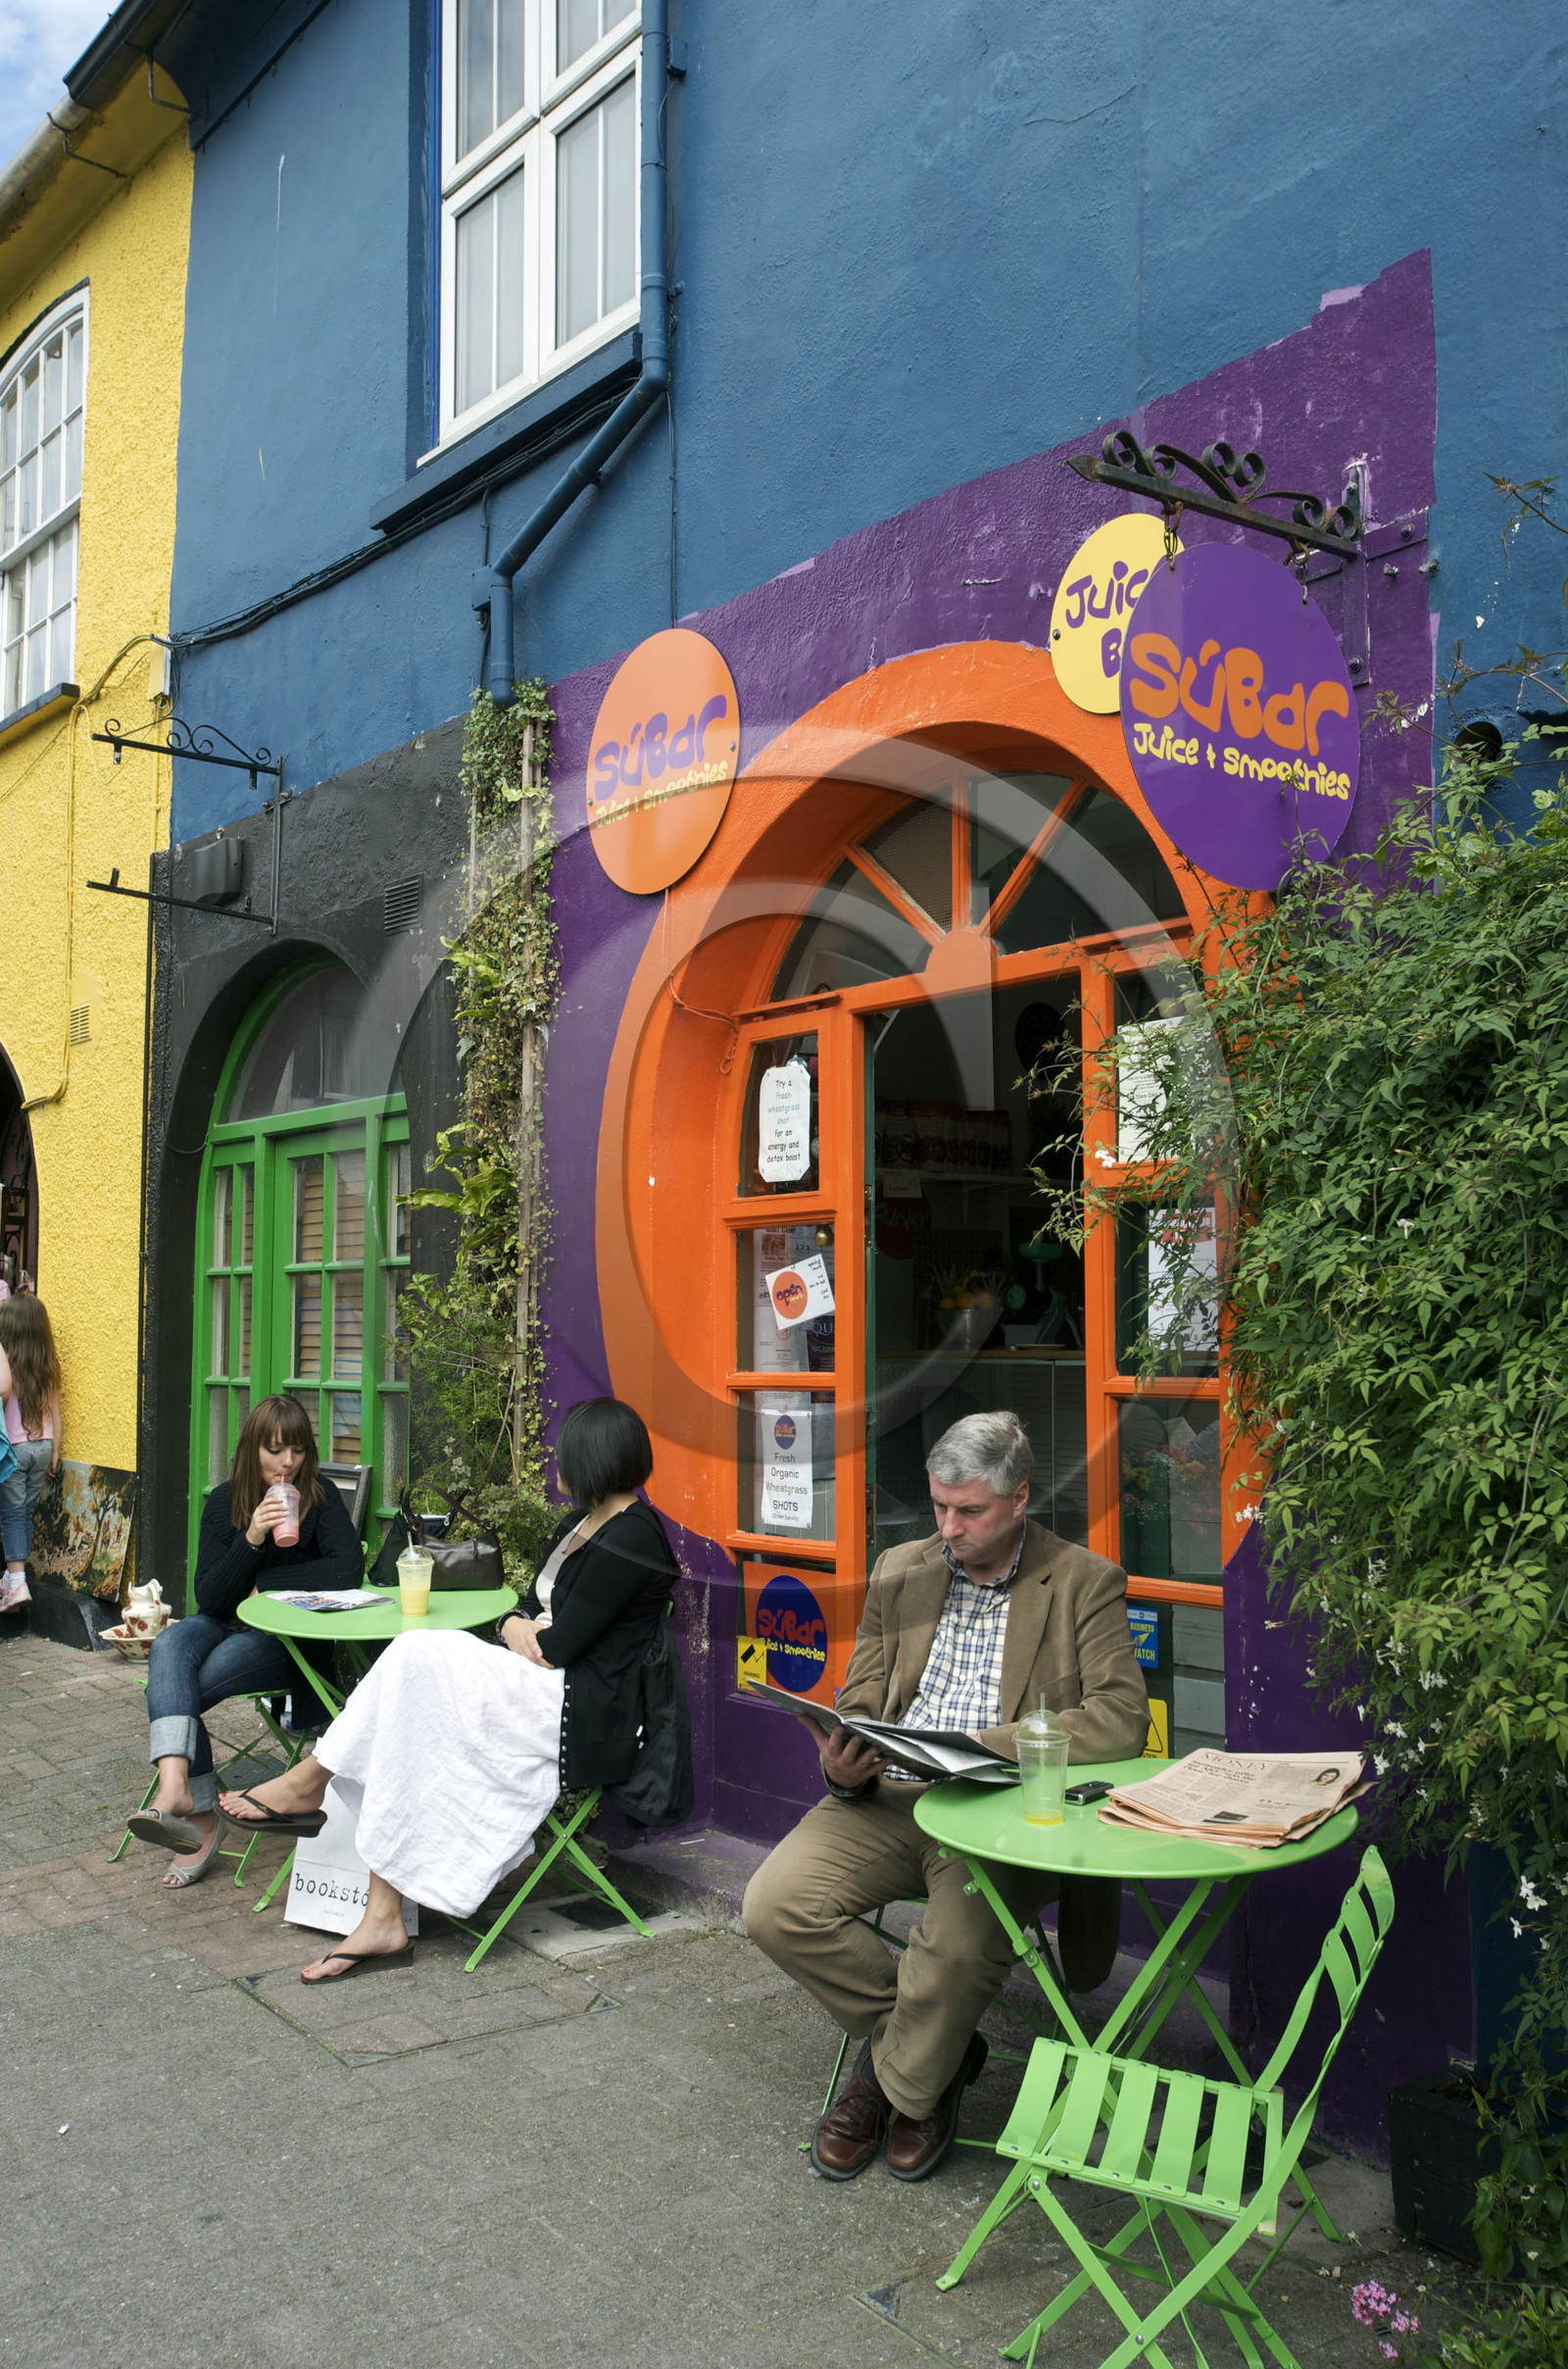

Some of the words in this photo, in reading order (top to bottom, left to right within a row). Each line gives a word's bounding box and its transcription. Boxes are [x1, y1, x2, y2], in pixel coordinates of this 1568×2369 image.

[1065, 561, 1149, 628] Juic
[1134, 722, 1199, 765] Juice
[596, 798, 630, 829] Juice
[768, 1104, 800, 1113] wheatgrass
[774, 1129, 783, 1138] for
[768, 1143, 786, 1152] energy
[774, 1453, 796, 1463] Fresh
[770, 1466, 800, 1480] Organic
[765, 1479, 808, 1496] Wheatgrass
[772, 1500, 799, 1511] SHOTS
[1130, 1621, 1154, 1634] BUSINESS
[764, 1638, 779, 1652] ice
[1202, 1752, 1271, 1771] MONEY
[295, 1873, 369, 1907] bookstó
